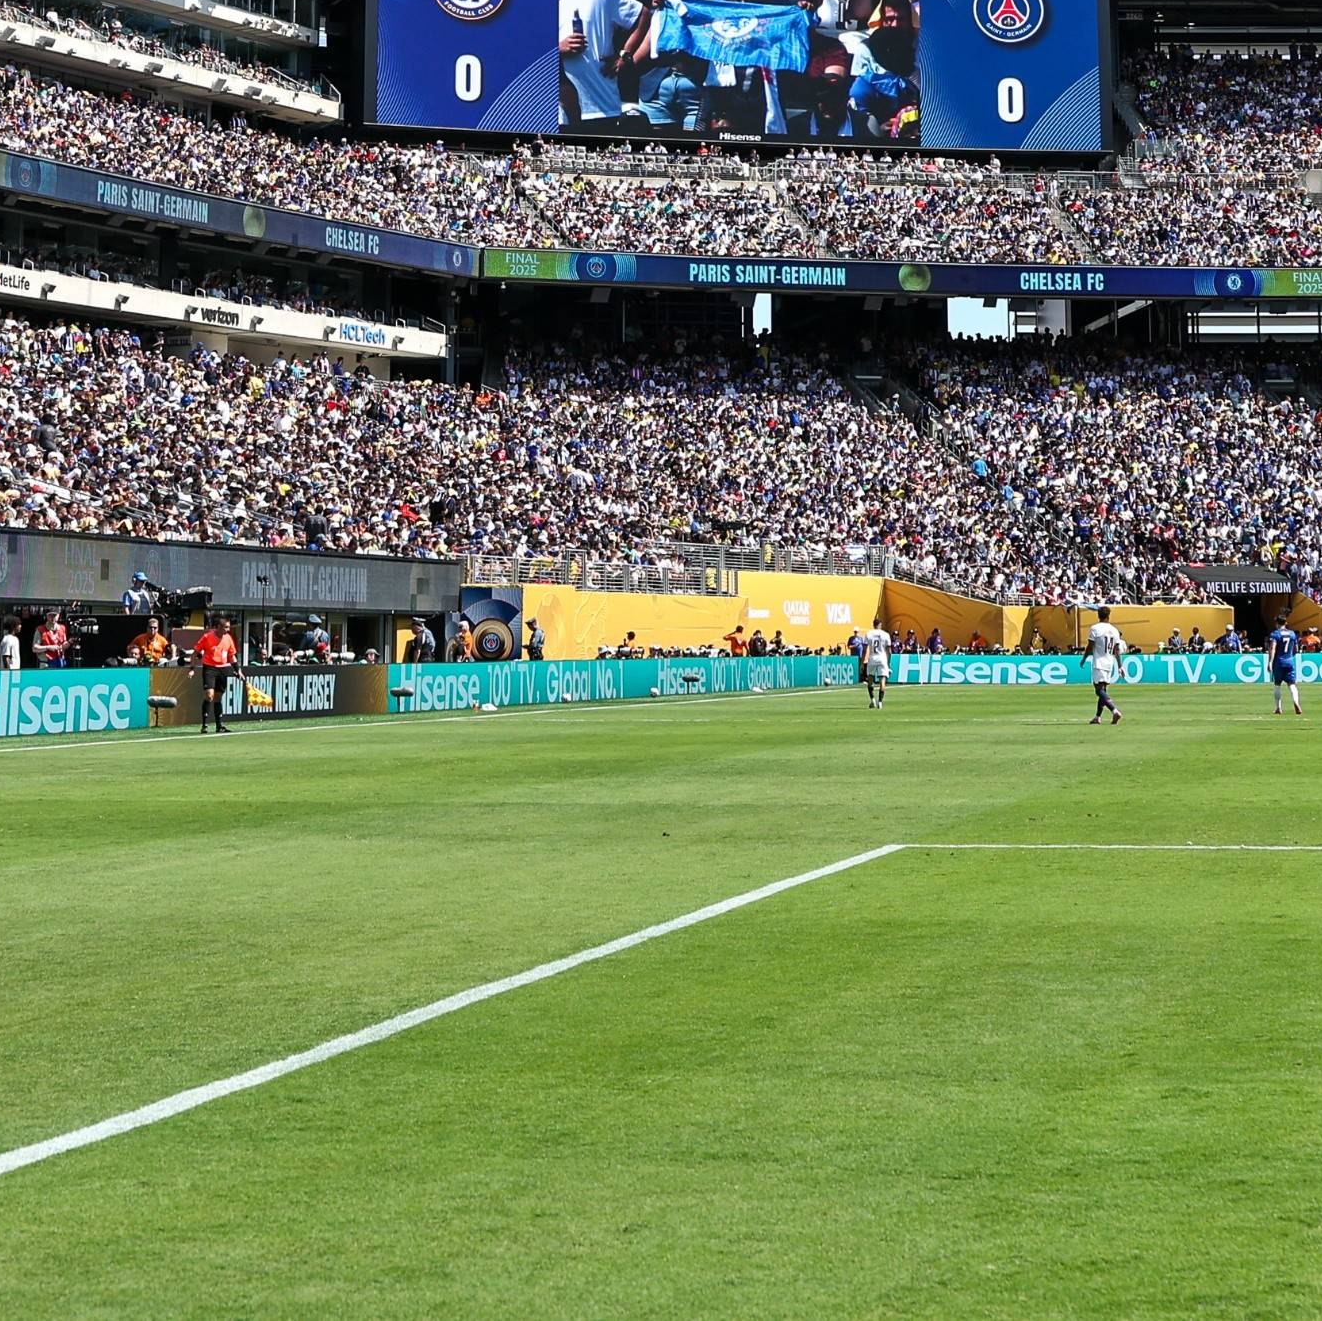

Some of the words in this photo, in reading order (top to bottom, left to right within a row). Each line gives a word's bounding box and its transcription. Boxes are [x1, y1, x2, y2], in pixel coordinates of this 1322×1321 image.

[455, 55, 481, 102] 0
[997, 77, 1024, 124] 0
[719, 132, 761, 141] Hisense
[97, 179, 128, 207] PARIS
[131, 187, 209, 224] SAINT-GERMAIN
[325, 226, 365, 253] CHELSEA
[367, 234, 379, 255] FC
[505, 252, 540, 264] FINAL
[509, 264, 537, 276] 2025
[689, 262, 731, 283] PARIS
[735, 263, 846, 286] SAINT-GERMAIN
[1020, 271, 1082, 291] CHELSEA
[1086, 272, 1104, 291] FC
[200, 306, 239, 327] verizon
[339, 322, 386, 346] HCLTech
[66, 569, 96, 595] 2025
[241, 561, 278, 599] PARIS
[281, 563, 368, 603] SAINT-GERMAIN
[1206, 581, 1246, 594] METLIFE
[1249, 582, 1291, 594] STADIUM
[825, 603, 851, 624] VISA
[1104, 636, 1115, 655] 14
[1282, 637, 1290, 653] 7
[657, 659, 706, 695] Hisense
[747, 657, 774, 690] Global
[817, 657, 854, 686] Hisense
[898, 654, 1068, 684] Hisense
[275, 676, 298, 712] NEW
[300, 674, 336, 711] JERSEY
[399, 664, 479, 712] Hisense
[546, 661, 590, 702] Global
